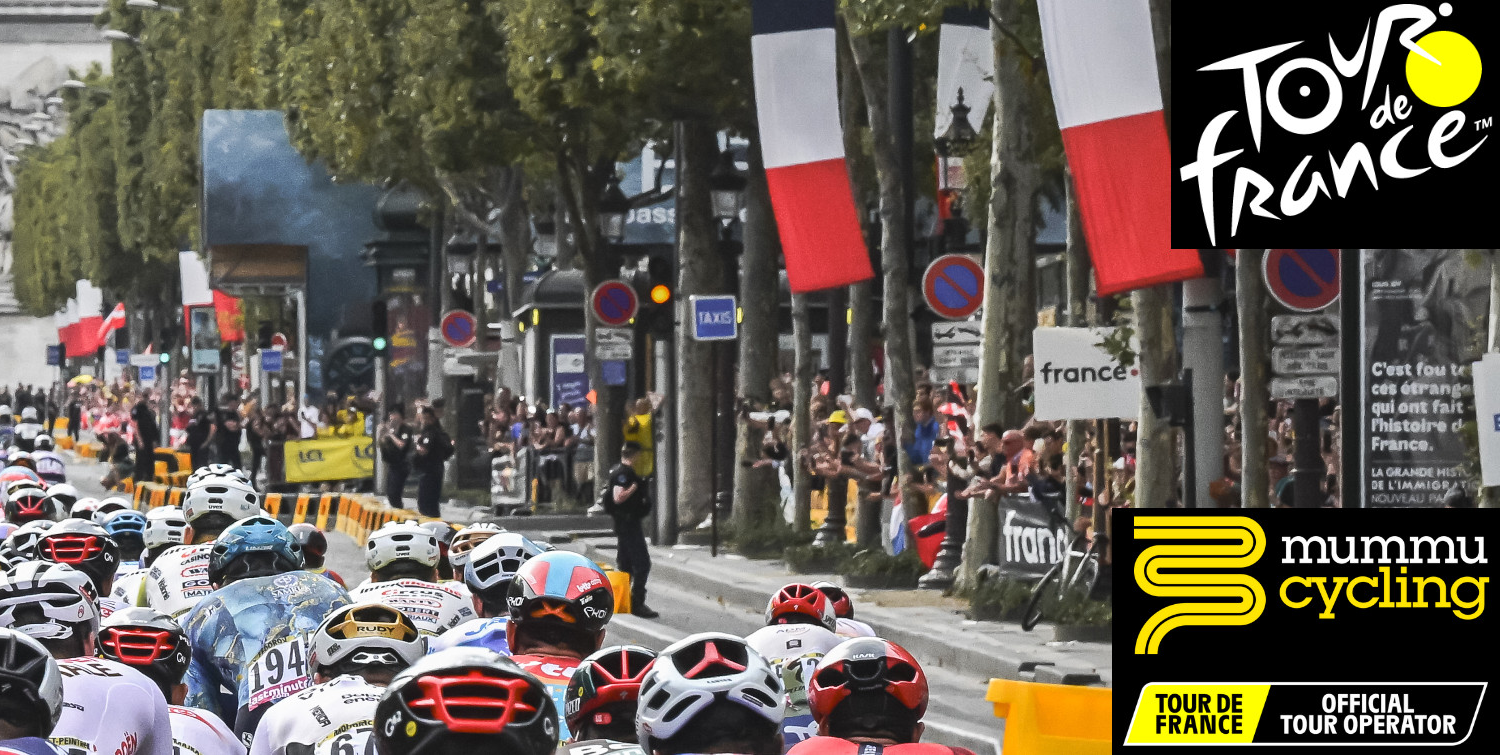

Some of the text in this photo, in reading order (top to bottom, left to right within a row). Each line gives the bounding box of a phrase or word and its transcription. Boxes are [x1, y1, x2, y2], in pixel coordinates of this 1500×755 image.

[699, 311, 732, 325] TAXIS
[1040, 362, 1127, 384] france
[1371, 362, 1412, 377] C'est
[1416, 361, 1446, 377] fou
[1371, 383, 1397, 396] ces
[1371, 399, 1464, 417] qui ont fait
[1371, 436, 1434, 452] France.
[1371, 467, 1384, 478] LA
[1386, 467, 1434, 478] GRANDE
[1371, 480, 1384, 490] DE
[356, 625, 396, 634] RUDY
[251, 639, 305, 695] 194
